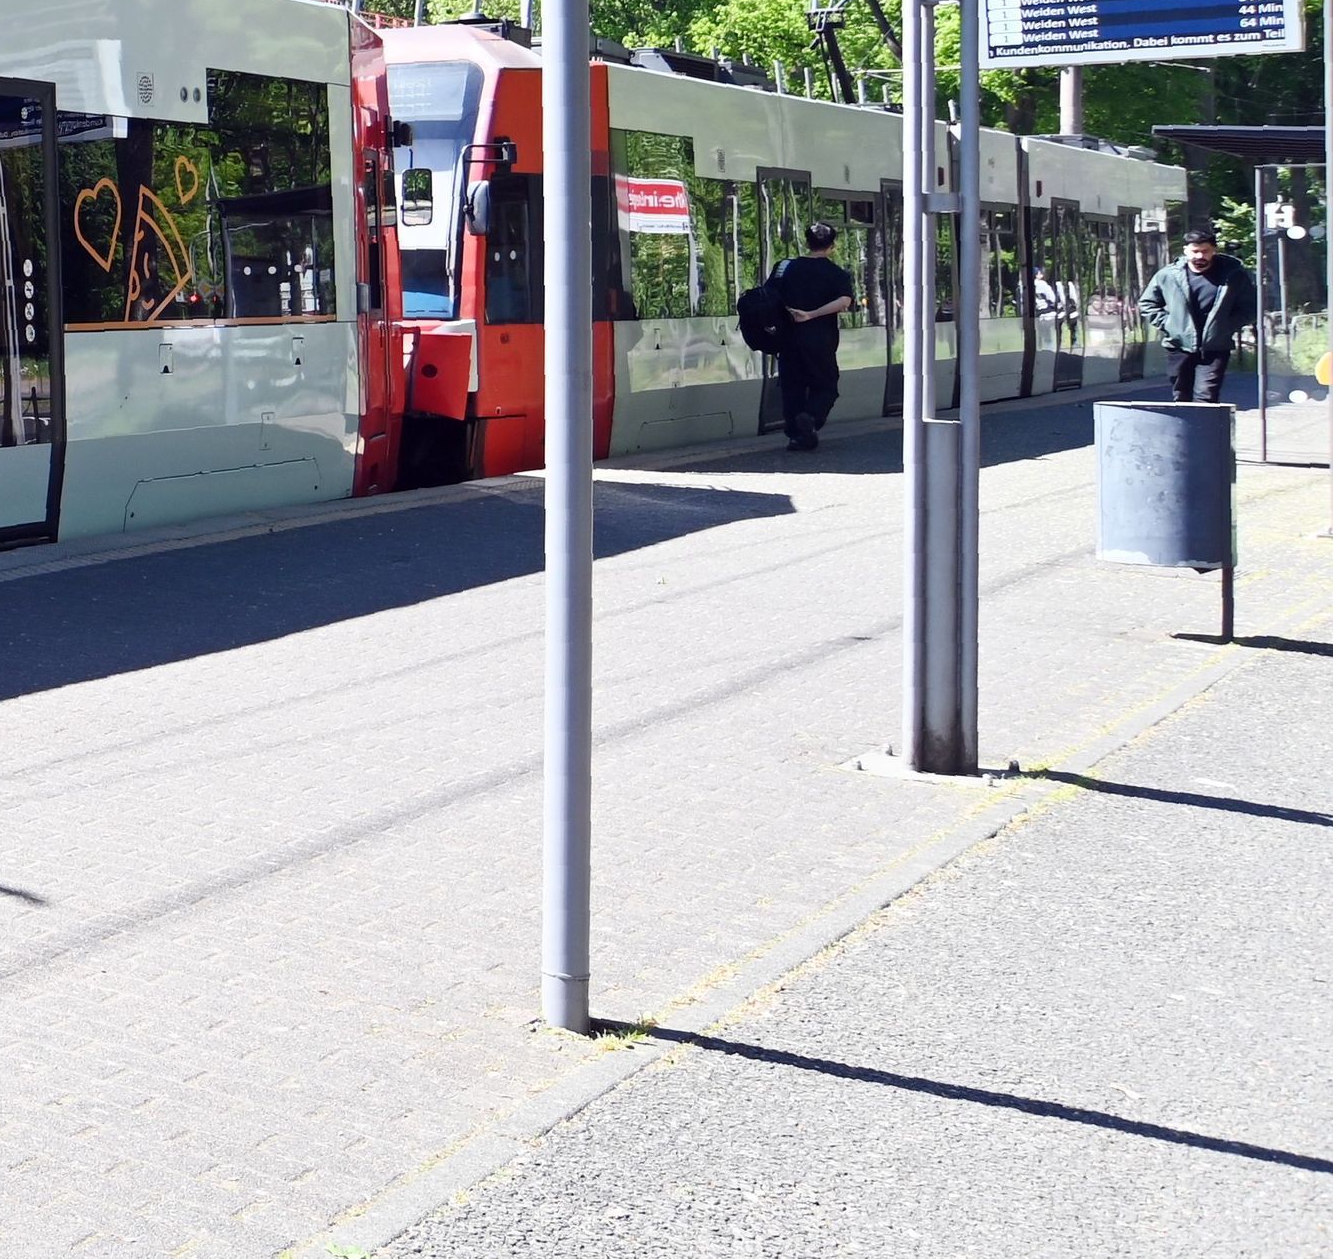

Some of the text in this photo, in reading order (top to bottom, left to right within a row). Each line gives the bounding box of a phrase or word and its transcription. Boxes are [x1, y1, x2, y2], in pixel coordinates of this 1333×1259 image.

[1021, 8, 1065, 18] Weiden
[1067, 4, 1097, 15] West
[1023, 20, 1066, 30] Weiden
[1068, 17, 1098, 27] West
[1238, 5, 1256, 15] 44
[1258, 3, 1283, 14] Min
[1023, 32, 1066, 42] Weiden
[1069, 29, 1099, 39] West
[1240, 18, 1257, 28] 64
[1260, 16, 1284, 27] Min
[996, 39, 1131, 56] Kundenkommunikation.
[1134, 37, 1167, 47] Dabei
[1171, 34, 1214, 45] kommt
[1217, 33, 1231, 42] es
[1233, 32, 1261, 41] zum
